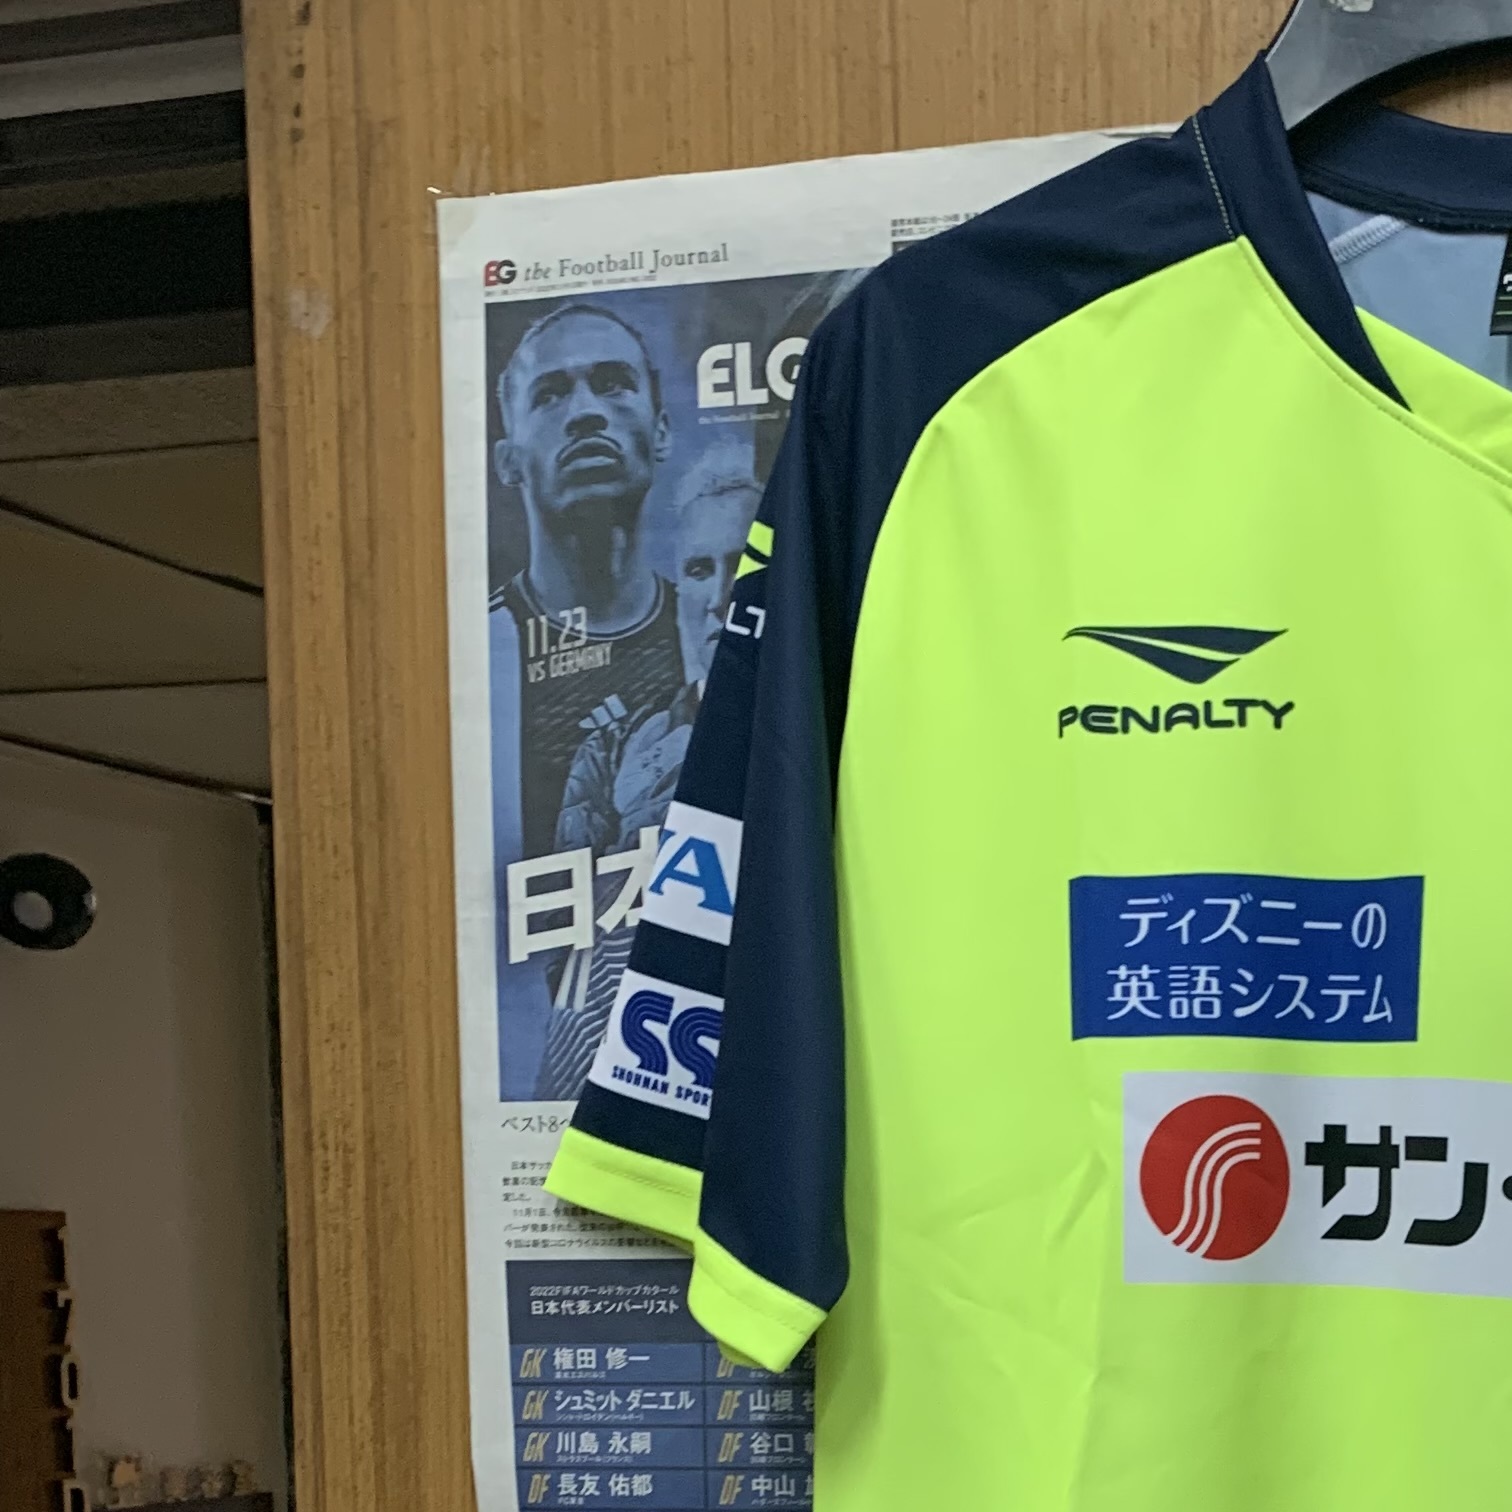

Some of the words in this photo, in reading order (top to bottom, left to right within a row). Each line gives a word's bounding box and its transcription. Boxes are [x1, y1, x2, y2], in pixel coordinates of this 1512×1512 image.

[524, 262, 552, 282] the
[559, 251, 644, 277] Football
[650, 243, 729, 273] Journal
[527, 606, 588, 658] 11.23
[527, 661, 547, 683] VS
[1059, 699, 1295, 738] PENALTY
[649, 828, 735, 916] A
[1119, 892, 1387, 949] ディズニーの
[1106, 964, 1393, 1024] 英語システム
[531, 1299, 680, 1315] 日本代表メンバーリスト
[554, 1389, 622, 1411] シュミット
[626, 1389, 695, 1411] ダニエル
[555, 1431, 599, 1454] 川島
[750, 1431, 794, 1454] 谷口
[557, 1473, 600, 1496] 長友
[751, 1474, 795, 1496] 中山
